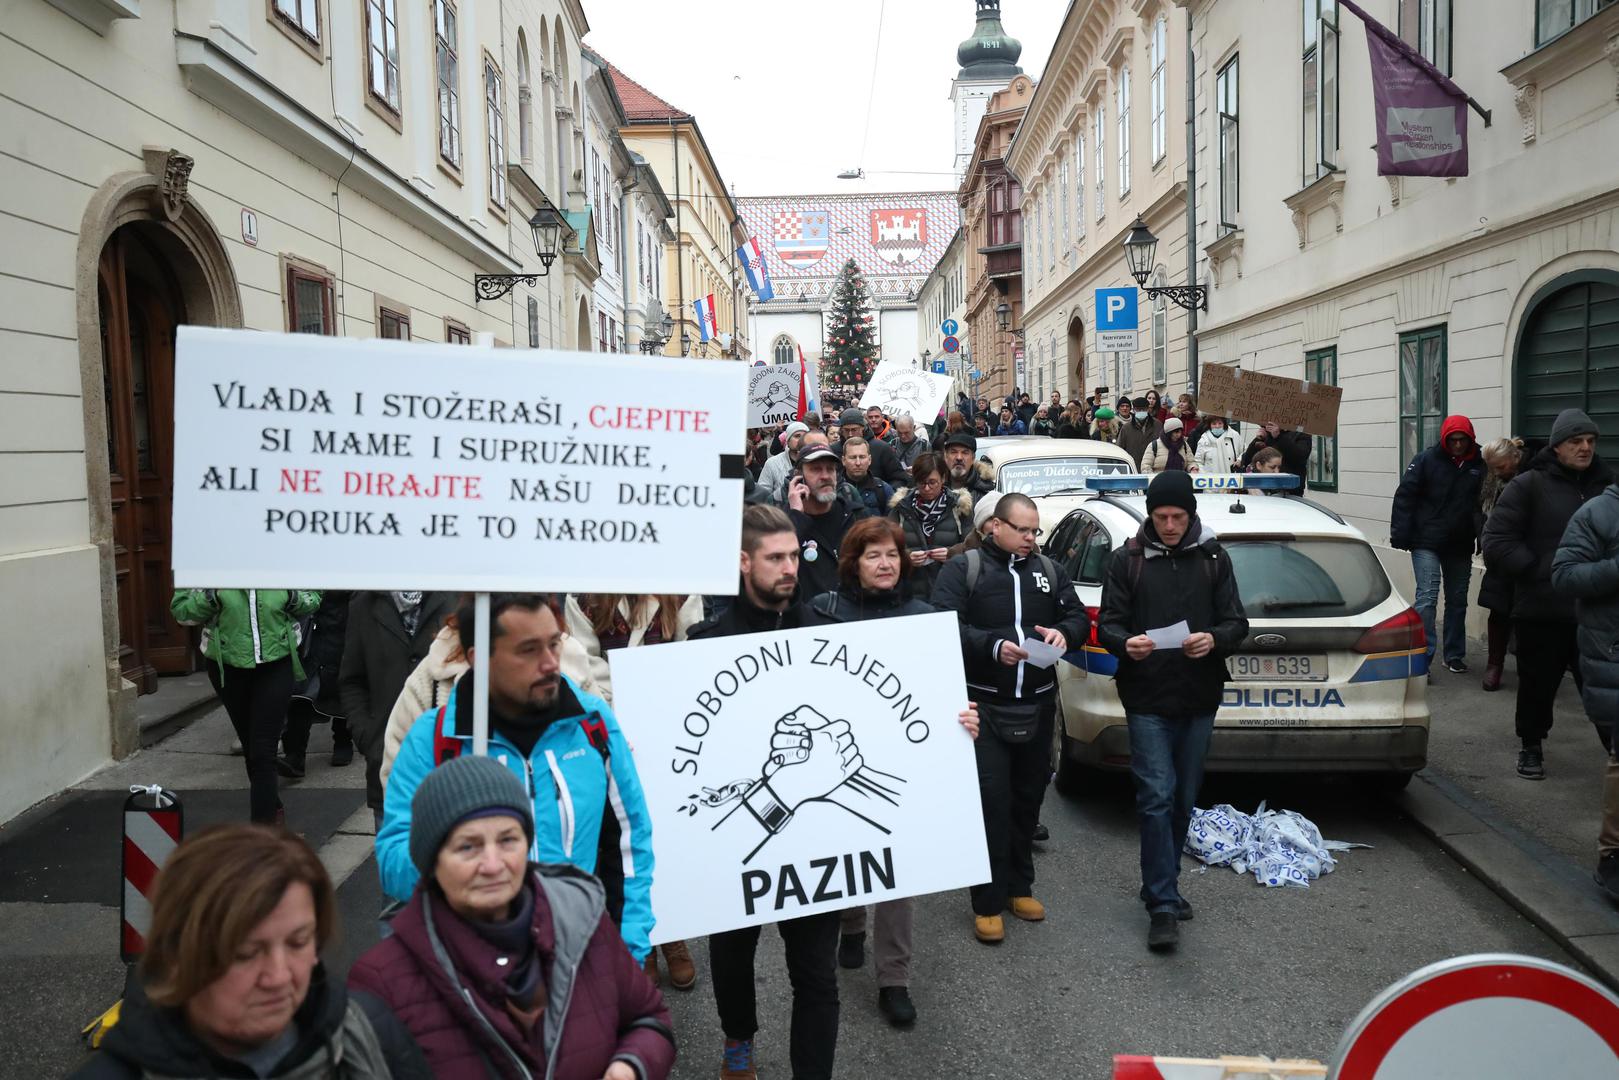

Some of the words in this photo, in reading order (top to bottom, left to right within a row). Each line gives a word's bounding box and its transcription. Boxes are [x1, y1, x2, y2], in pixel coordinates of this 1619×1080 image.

[1107, 295, 1125, 322] P
[935, 363, 943, 372] P
[749, 367, 775, 397] SLOBODNI
[778, 366, 801, 383] ZAJED
[213, 381, 333, 414] VLADA
[354, 391, 363, 416] I
[588, 405, 711, 433] CJEPITE
[762, 412, 798, 425] UMAG
[881, 404, 911, 417] PULA
[260, 427, 291, 453] SI
[312, 429, 413, 457] MAME
[432, 435, 441, 459] I
[1044, 466, 1078, 477] Didov
[200, 465, 259, 492] ALI
[279, 468, 322, 494] NE
[343, 471, 481, 499] DIRAJTE
[510, 474, 591, 504] NAŠU
[618, 482, 716, 508] DJECU.
[264, 508, 401, 536] PORUKA
[421, 514, 459, 537] JE
[478, 515, 517, 539] TO
[535, 517, 659, 544] NARODA
[1032, 572, 1051, 593] TS
[1276, 656, 1311, 675] 639
[672, 640, 792, 776] SLOBODNI
[810, 638, 930, 744] ZAJEDNO
[1220, 688, 1346, 708] OLICIJA
[1239, 717, 1309, 727] www.policija.hr
[741, 847, 897, 916] PAZIN
